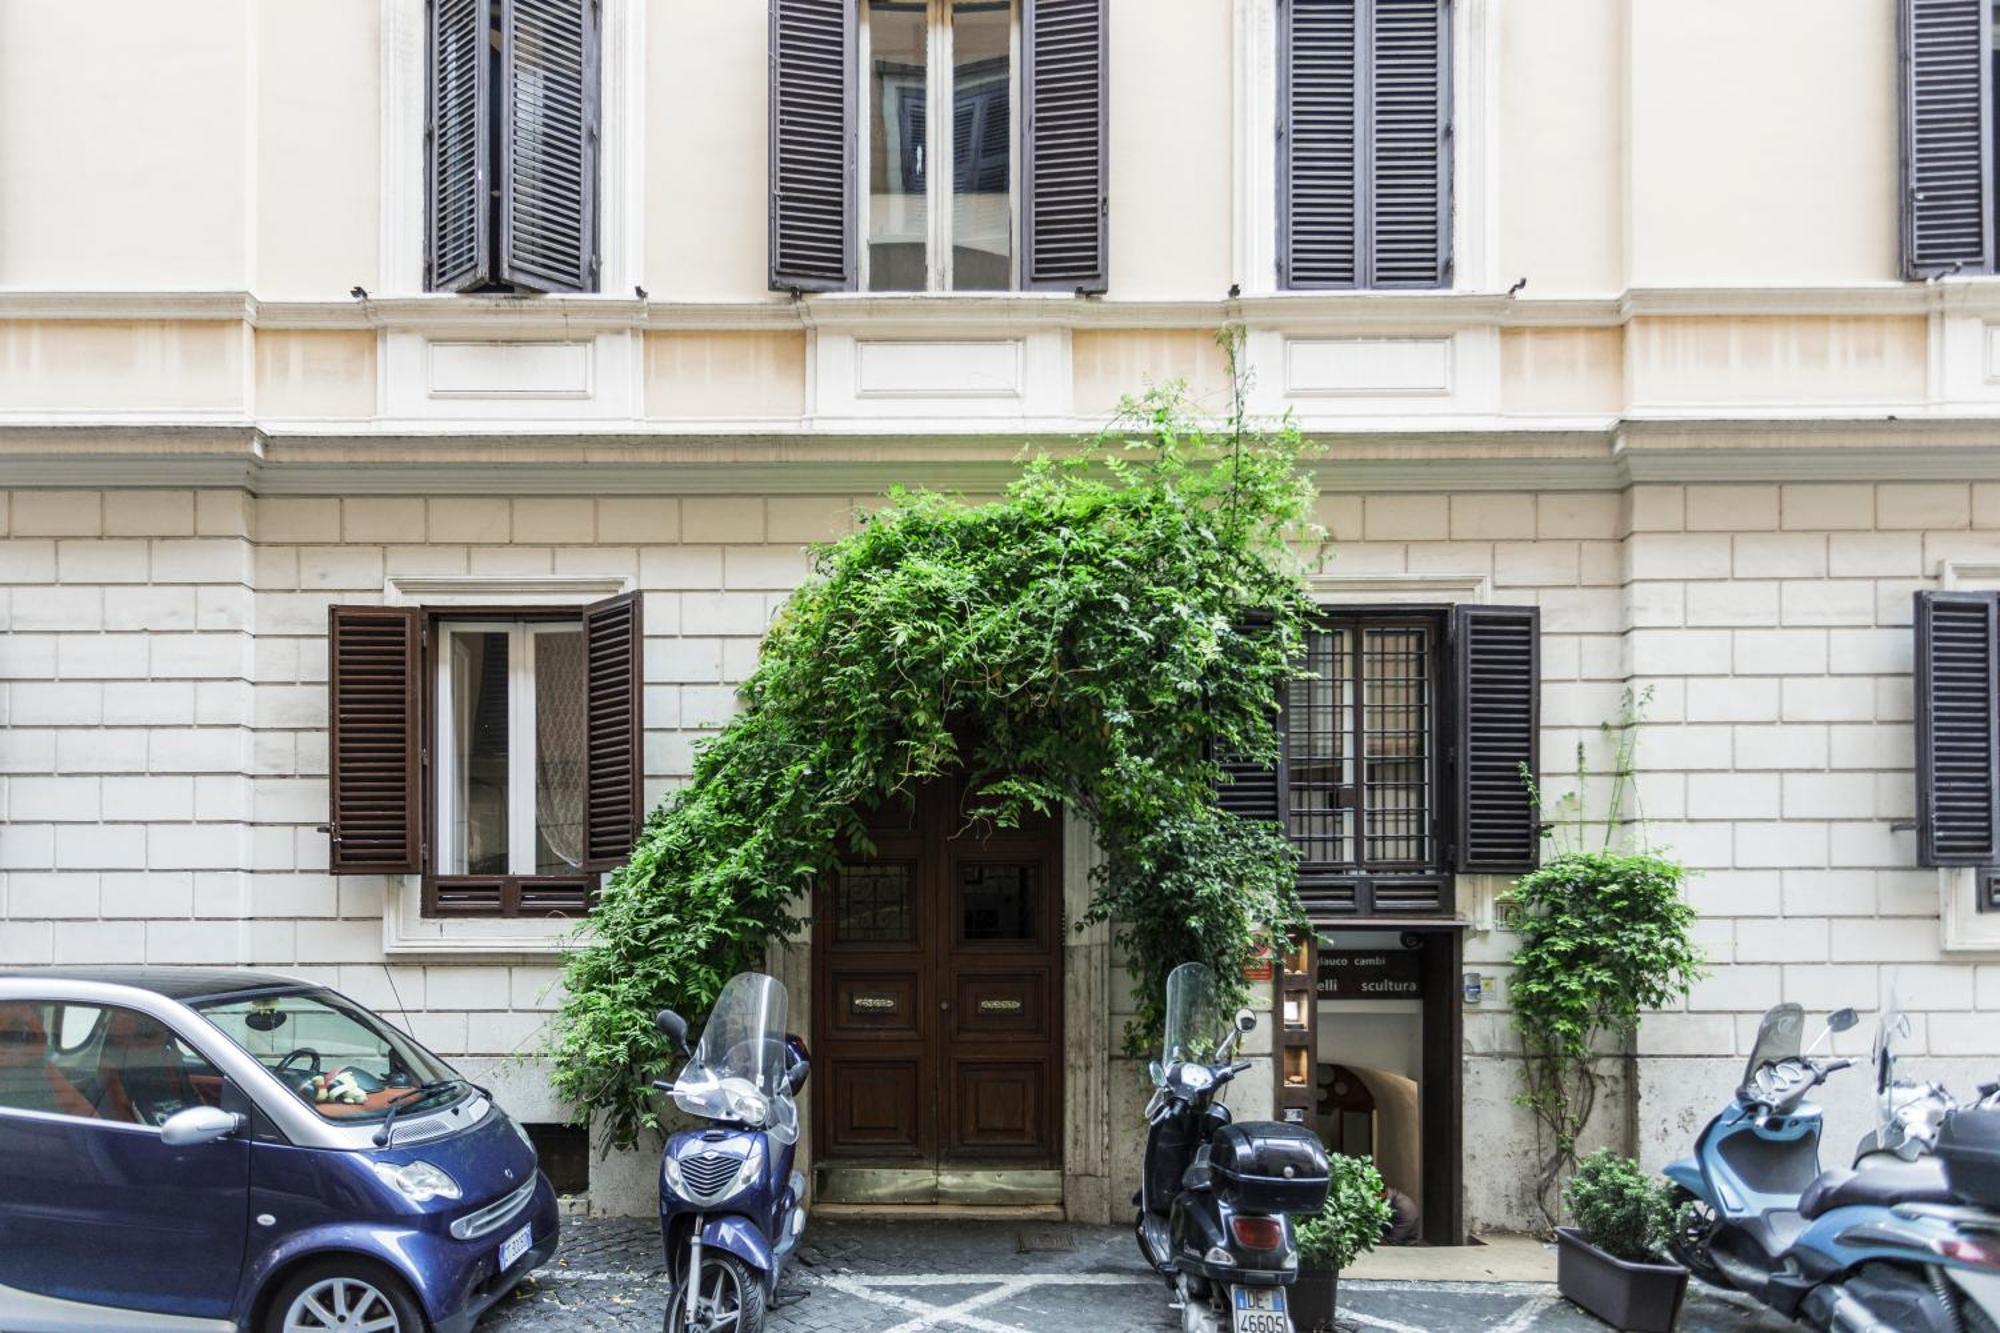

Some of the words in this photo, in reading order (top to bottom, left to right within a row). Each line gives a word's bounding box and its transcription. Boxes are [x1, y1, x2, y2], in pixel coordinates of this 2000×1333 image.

[1354, 956, 1386, 966] cambi
[1360, 979, 1417, 992] scultura
[1247, 1290, 1265, 1309] DE
[1240, 1314, 1284, 1333] 46605
